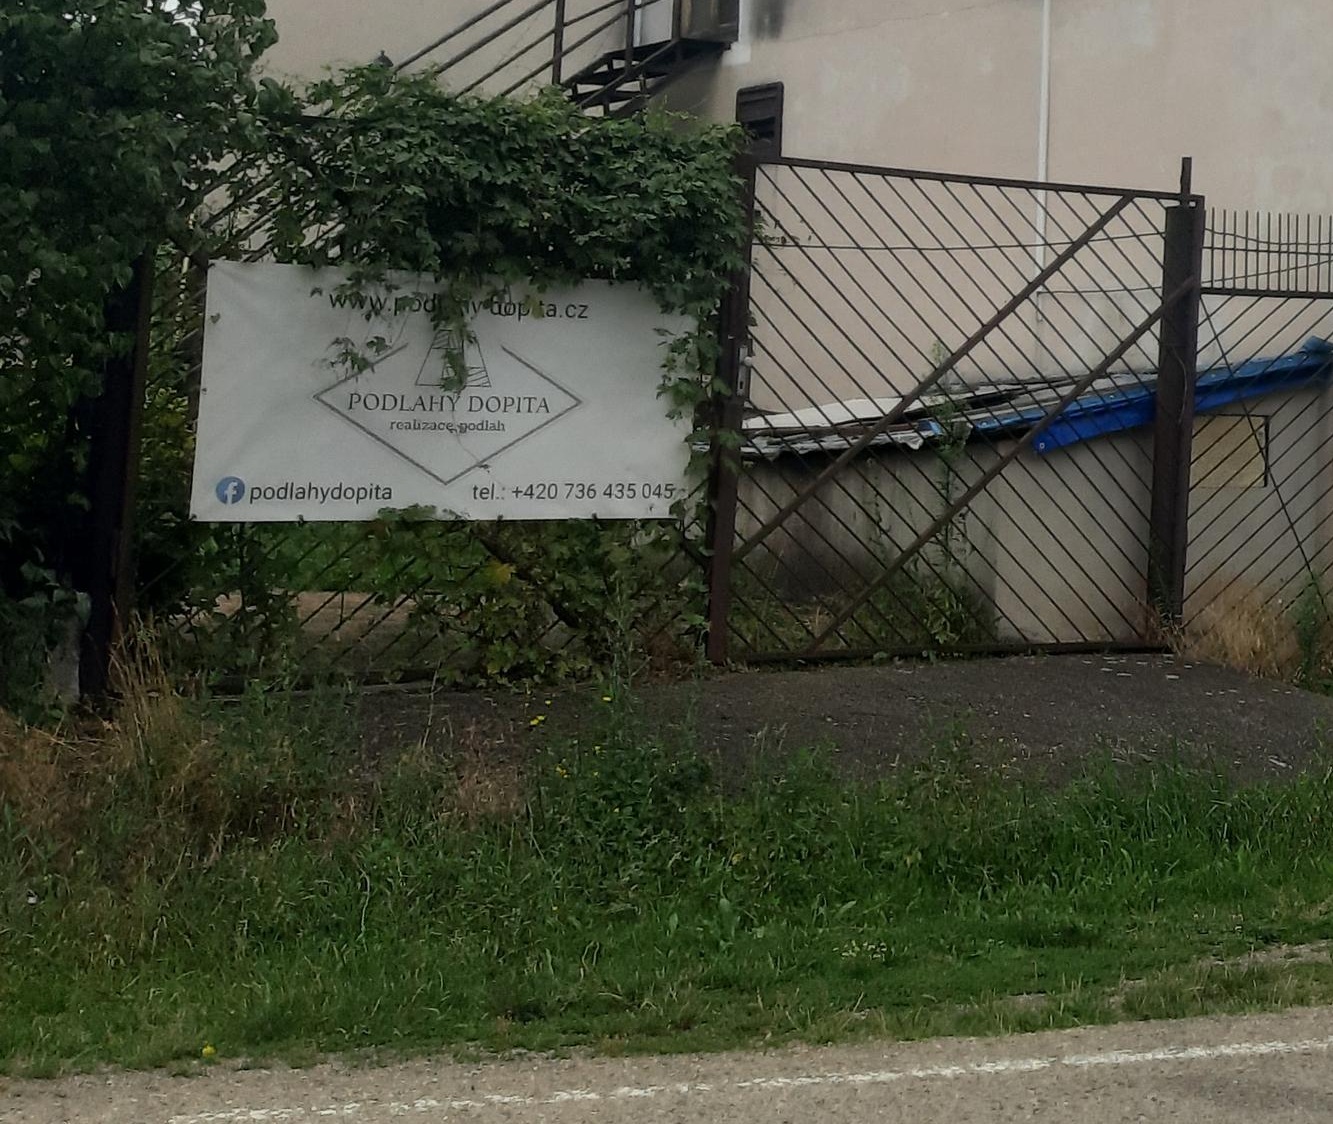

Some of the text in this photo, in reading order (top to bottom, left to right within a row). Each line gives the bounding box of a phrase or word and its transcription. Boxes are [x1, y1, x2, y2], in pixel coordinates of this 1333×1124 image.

[348, 391, 551, 414] PODLAHY DOPITA
[389, 418, 506, 434] realizace podlah
[249, 482, 393, 504] podlahydopita
[472, 483, 674, 501] tel.: +420 736 435 045
